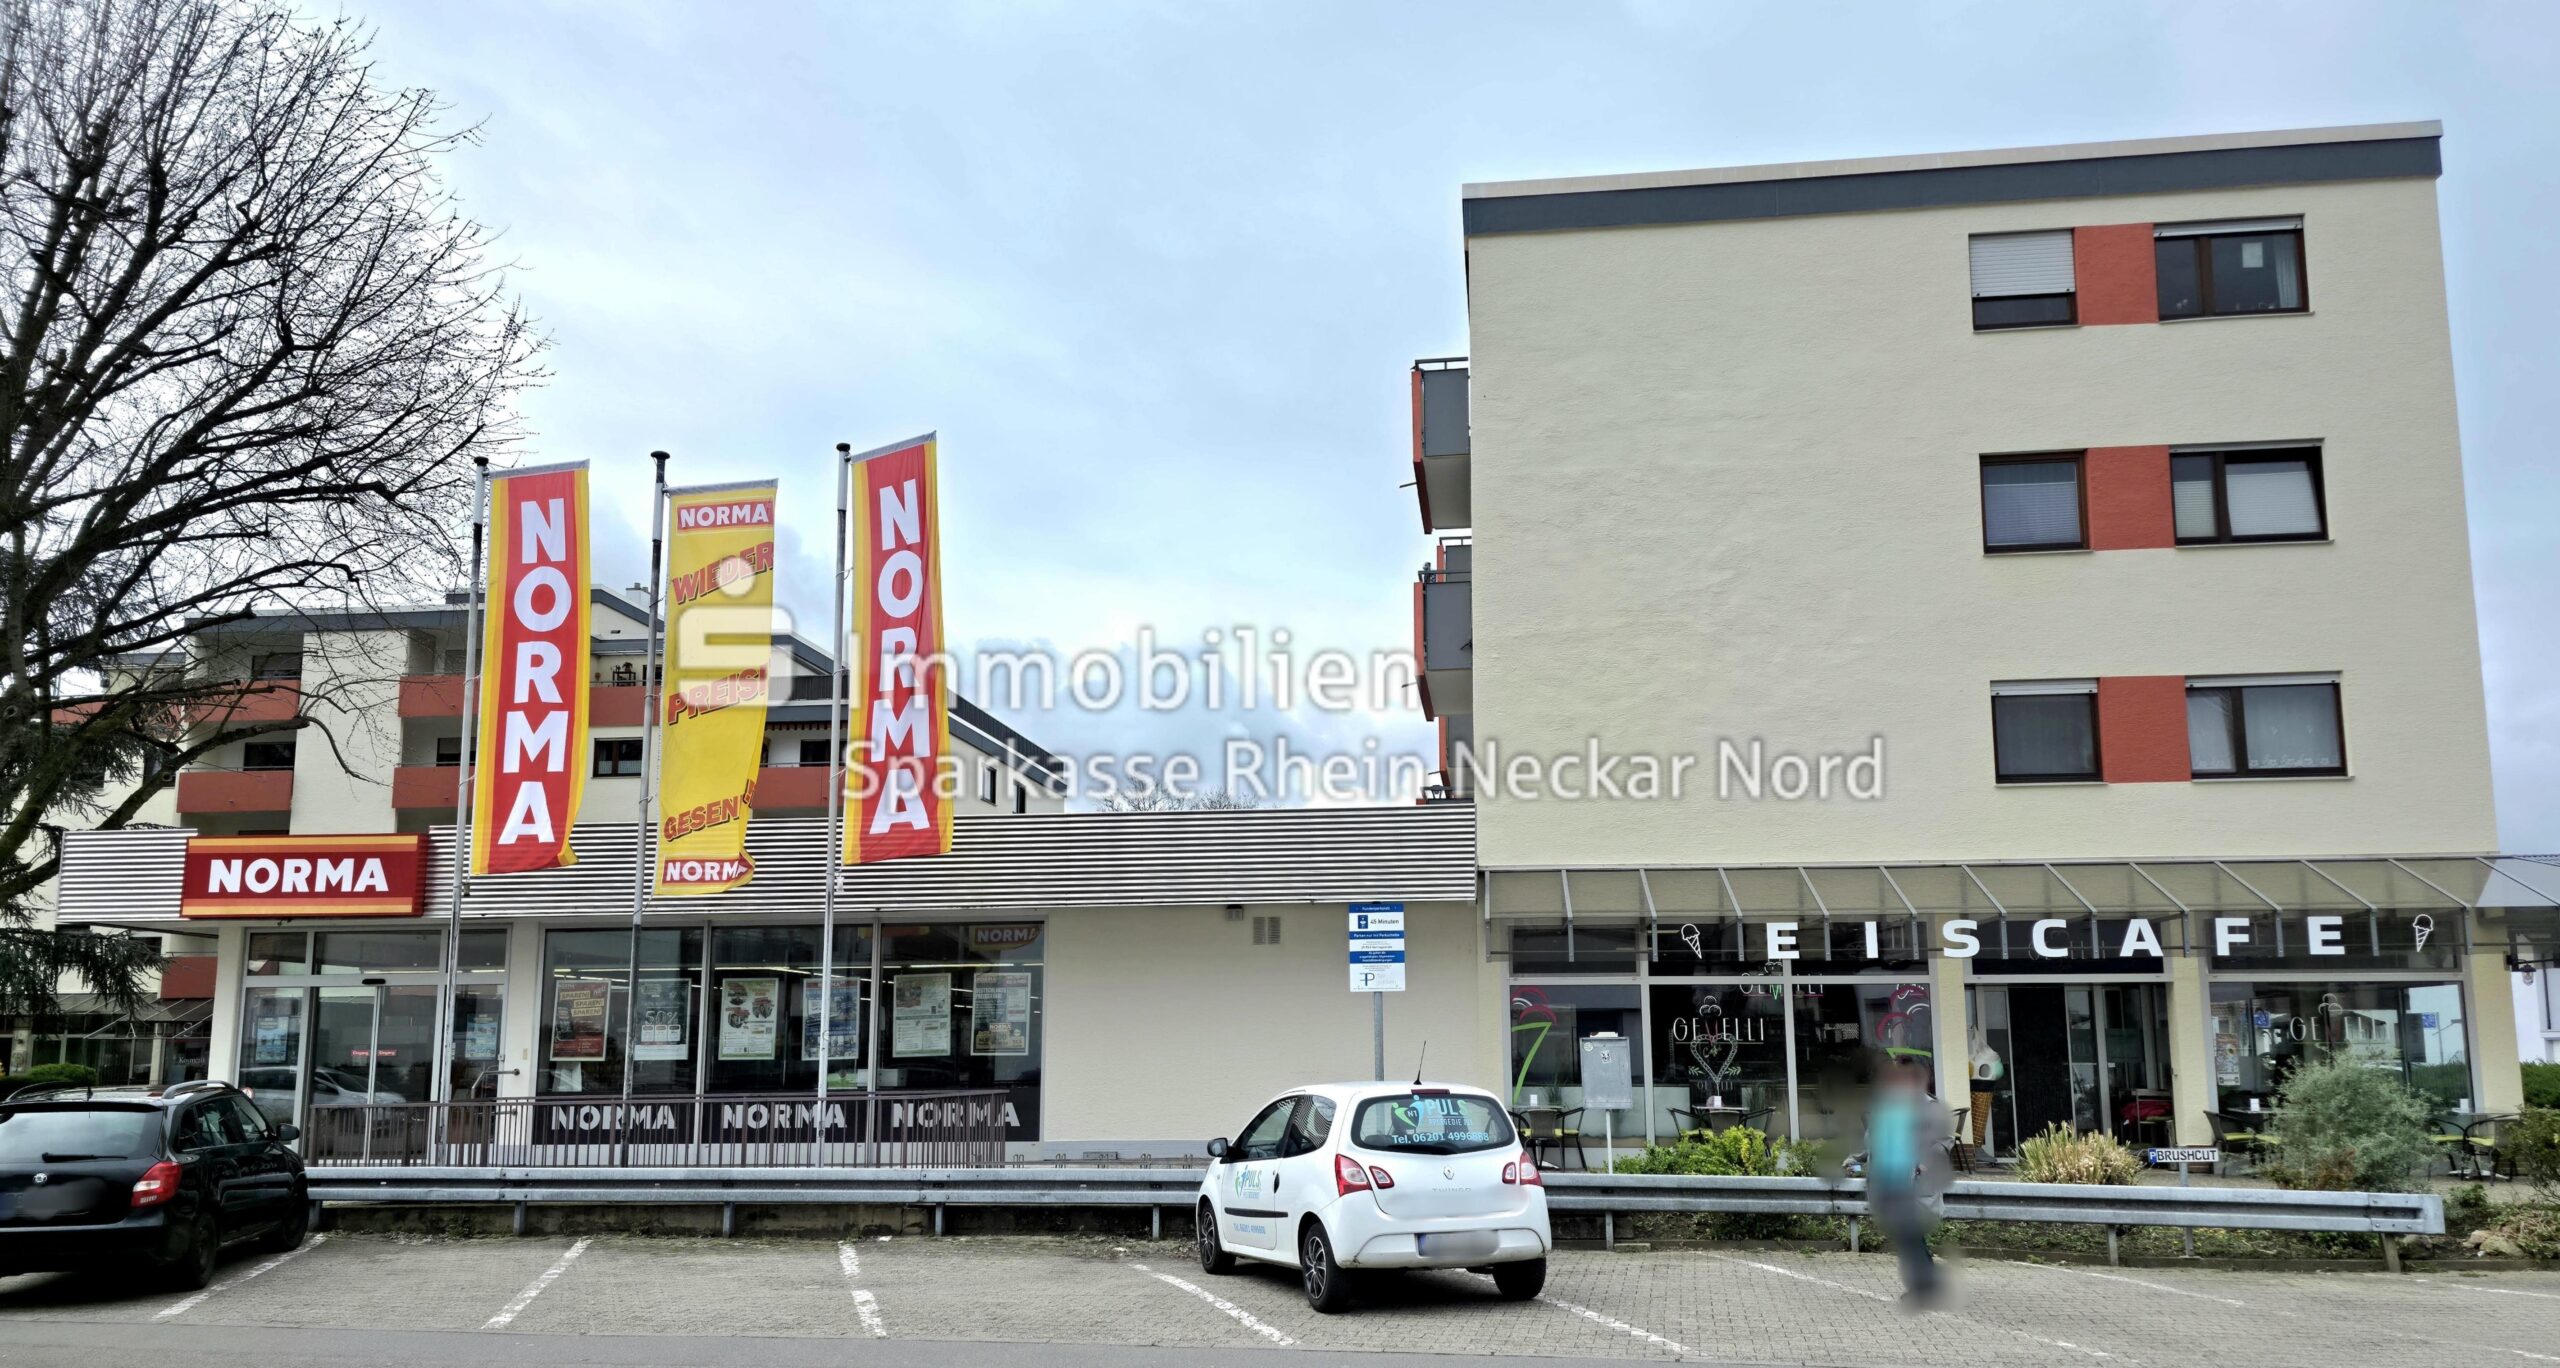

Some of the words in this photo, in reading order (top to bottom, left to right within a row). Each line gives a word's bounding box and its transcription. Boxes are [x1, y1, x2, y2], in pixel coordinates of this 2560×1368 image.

[681, 503, 769, 529] NORMA
[672, 541, 774, 604] WIEDER
[869, 478, 931, 835] NORMA
[499, 498, 573, 845] NORMA
[208, 858, 389, 894] NORMA
[551, 1105, 677, 1131] NORMA
[722, 1104, 847, 1129] NORMA
[891, 1102, 1021, 1128] NORMA
[1392, 1135, 1411, 1144] Tel.
[1413, 1133, 1445, 1143] 06201
[2157, 1150, 2216, 1161] BRUSHCUT
